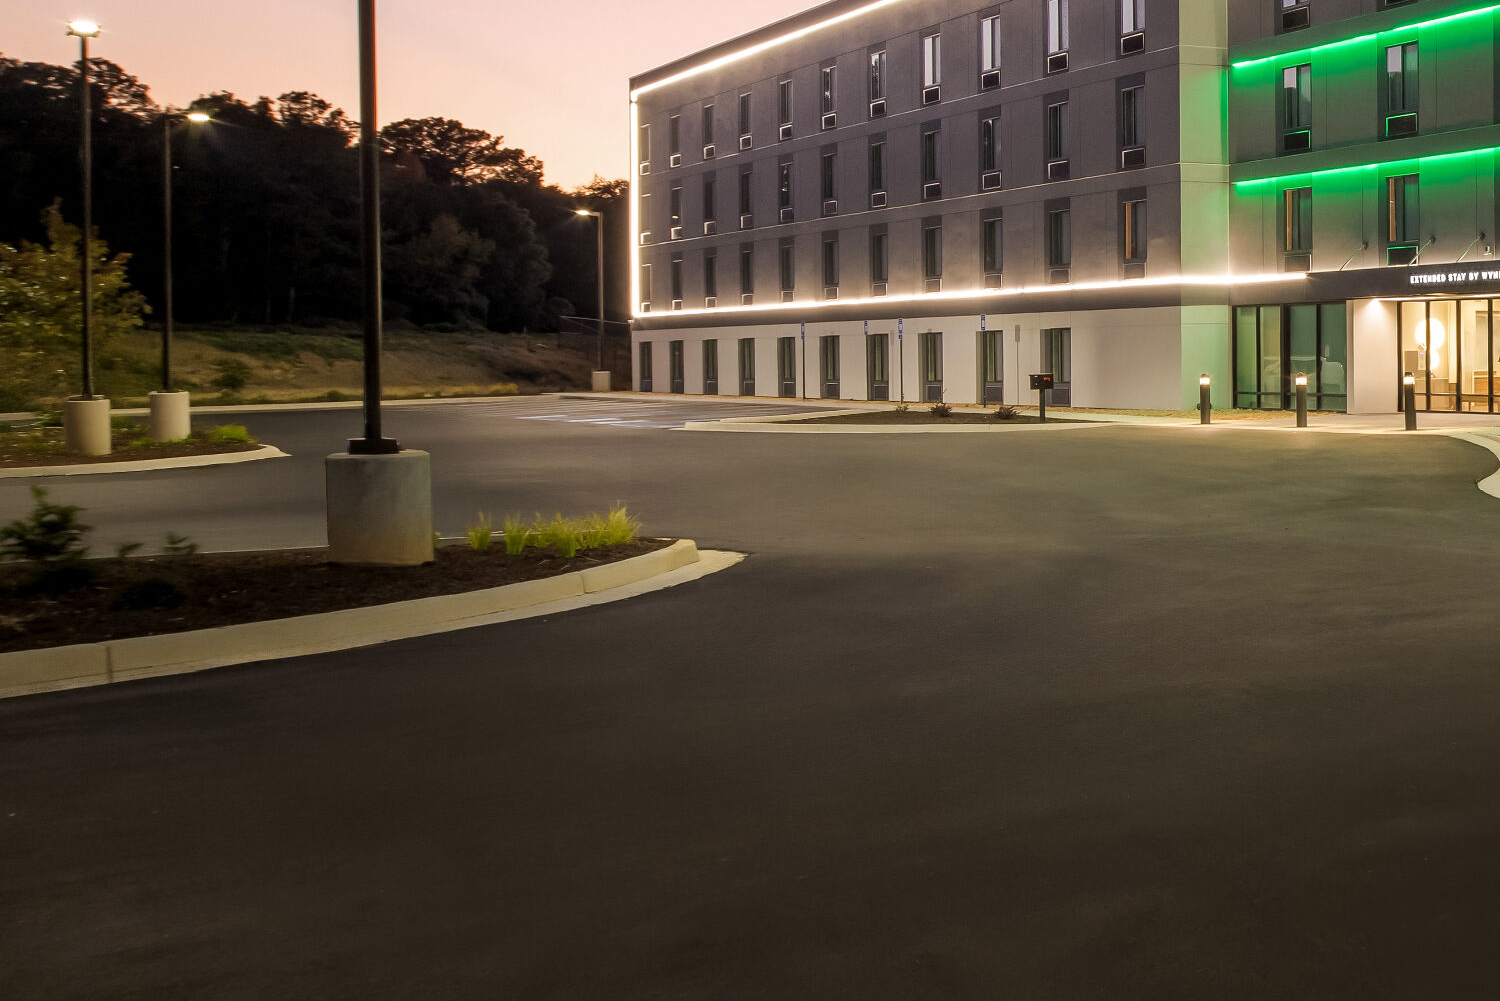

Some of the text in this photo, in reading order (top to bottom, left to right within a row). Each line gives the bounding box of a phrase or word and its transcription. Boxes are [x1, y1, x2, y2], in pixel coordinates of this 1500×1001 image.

[1410, 274, 1446, 284] EXTENDED
[1448, 272, 1466, 282] STAY
[1468, 271, 1479, 281] BY
